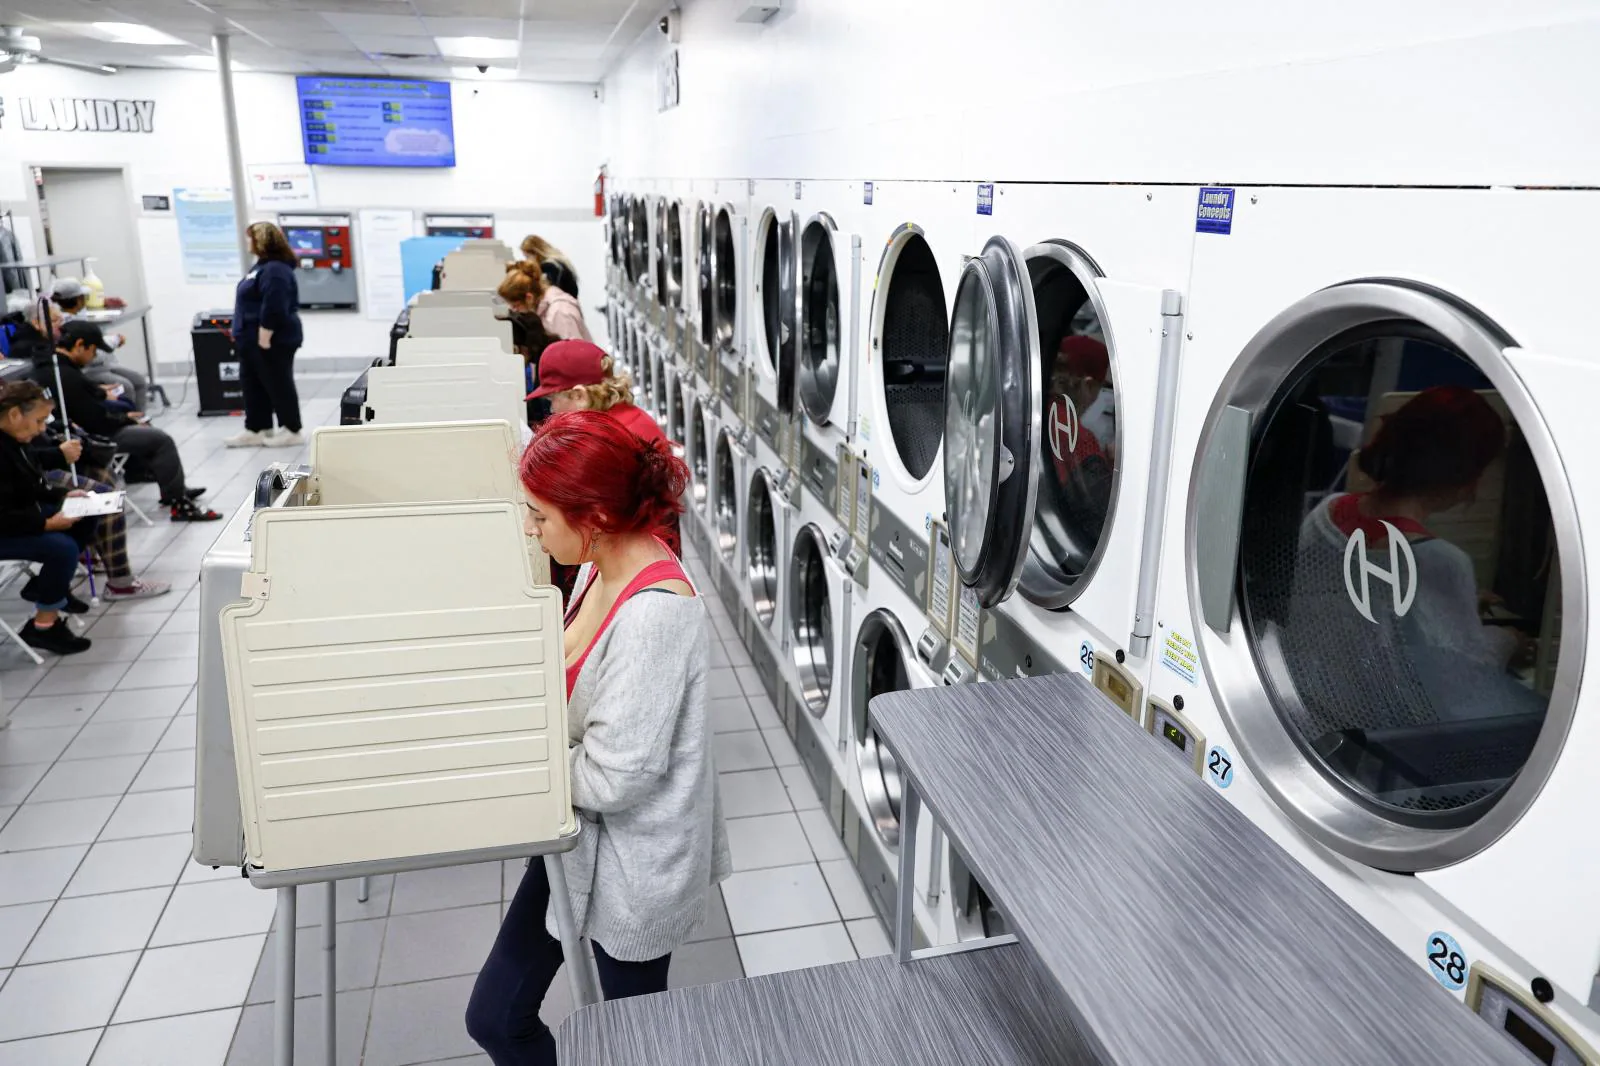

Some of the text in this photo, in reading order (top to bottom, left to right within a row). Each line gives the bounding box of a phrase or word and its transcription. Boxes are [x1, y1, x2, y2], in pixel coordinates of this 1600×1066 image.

[19, 97, 155, 132] LAUNDRY
[1199, 204, 1230, 219] Concepts
[1202, 191, 1229, 206] Laundry
[1081, 644, 1093, 669] 26
[1208, 750, 1231, 780] 27
[1429, 937, 1465, 984] 28
